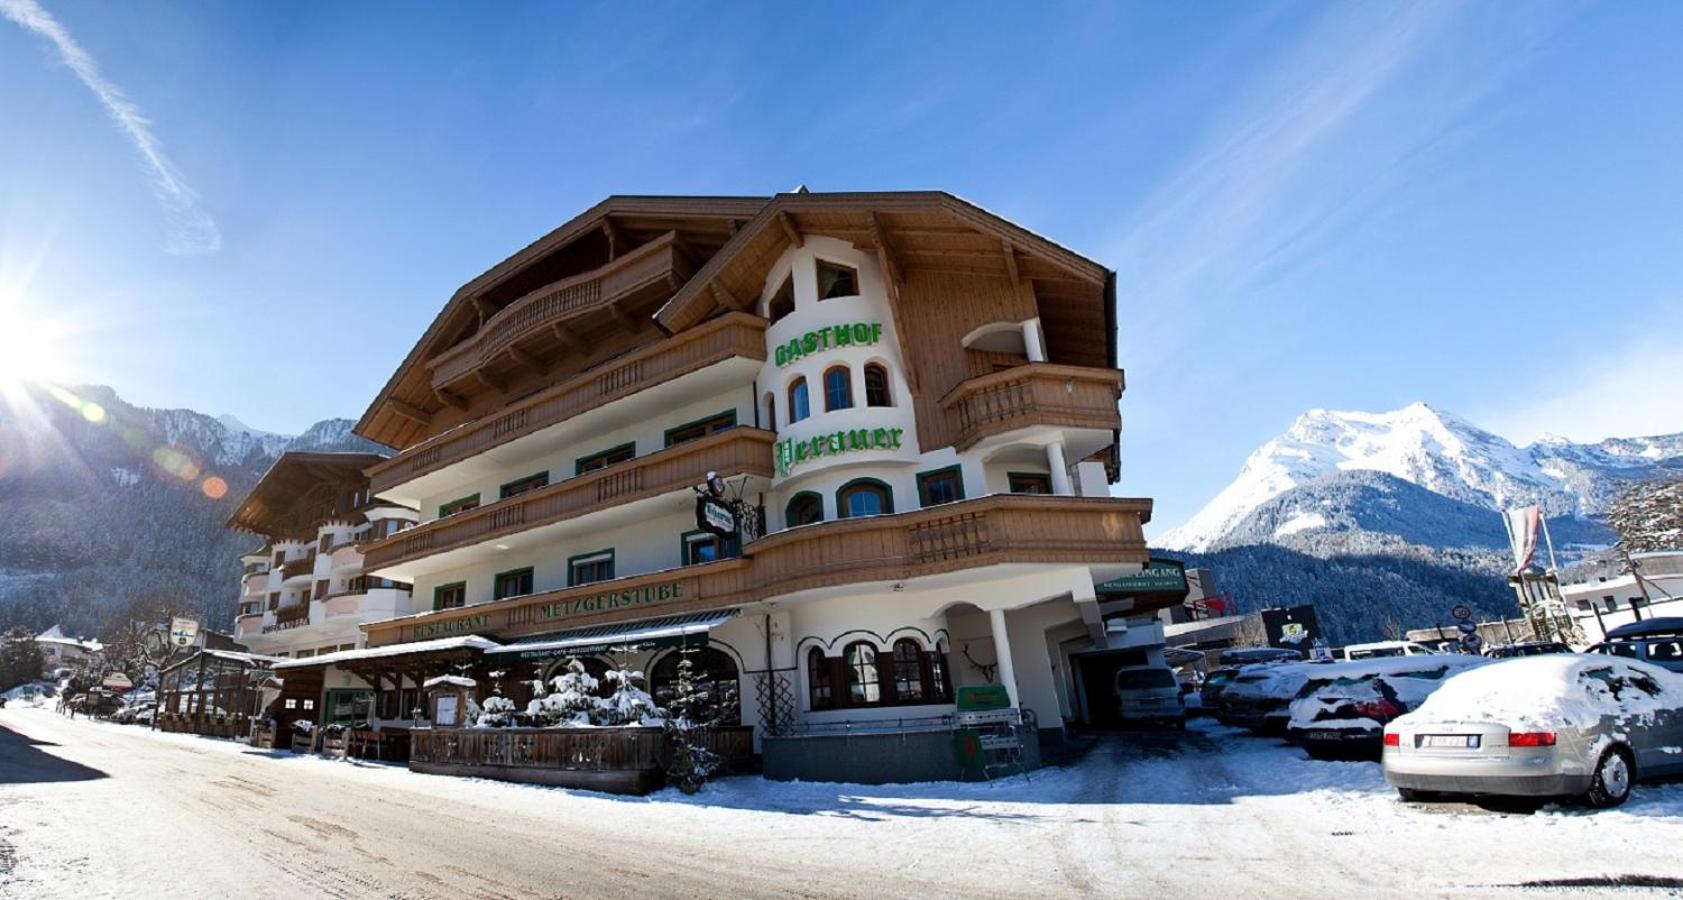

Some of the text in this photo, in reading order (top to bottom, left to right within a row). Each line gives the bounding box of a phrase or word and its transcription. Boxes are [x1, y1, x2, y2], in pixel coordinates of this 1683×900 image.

[775, 322, 883, 367] GASTHOF
[776, 427, 904, 476] Perauer
[413, 582, 683, 638] RESTAURANT METZGERSTUBE
